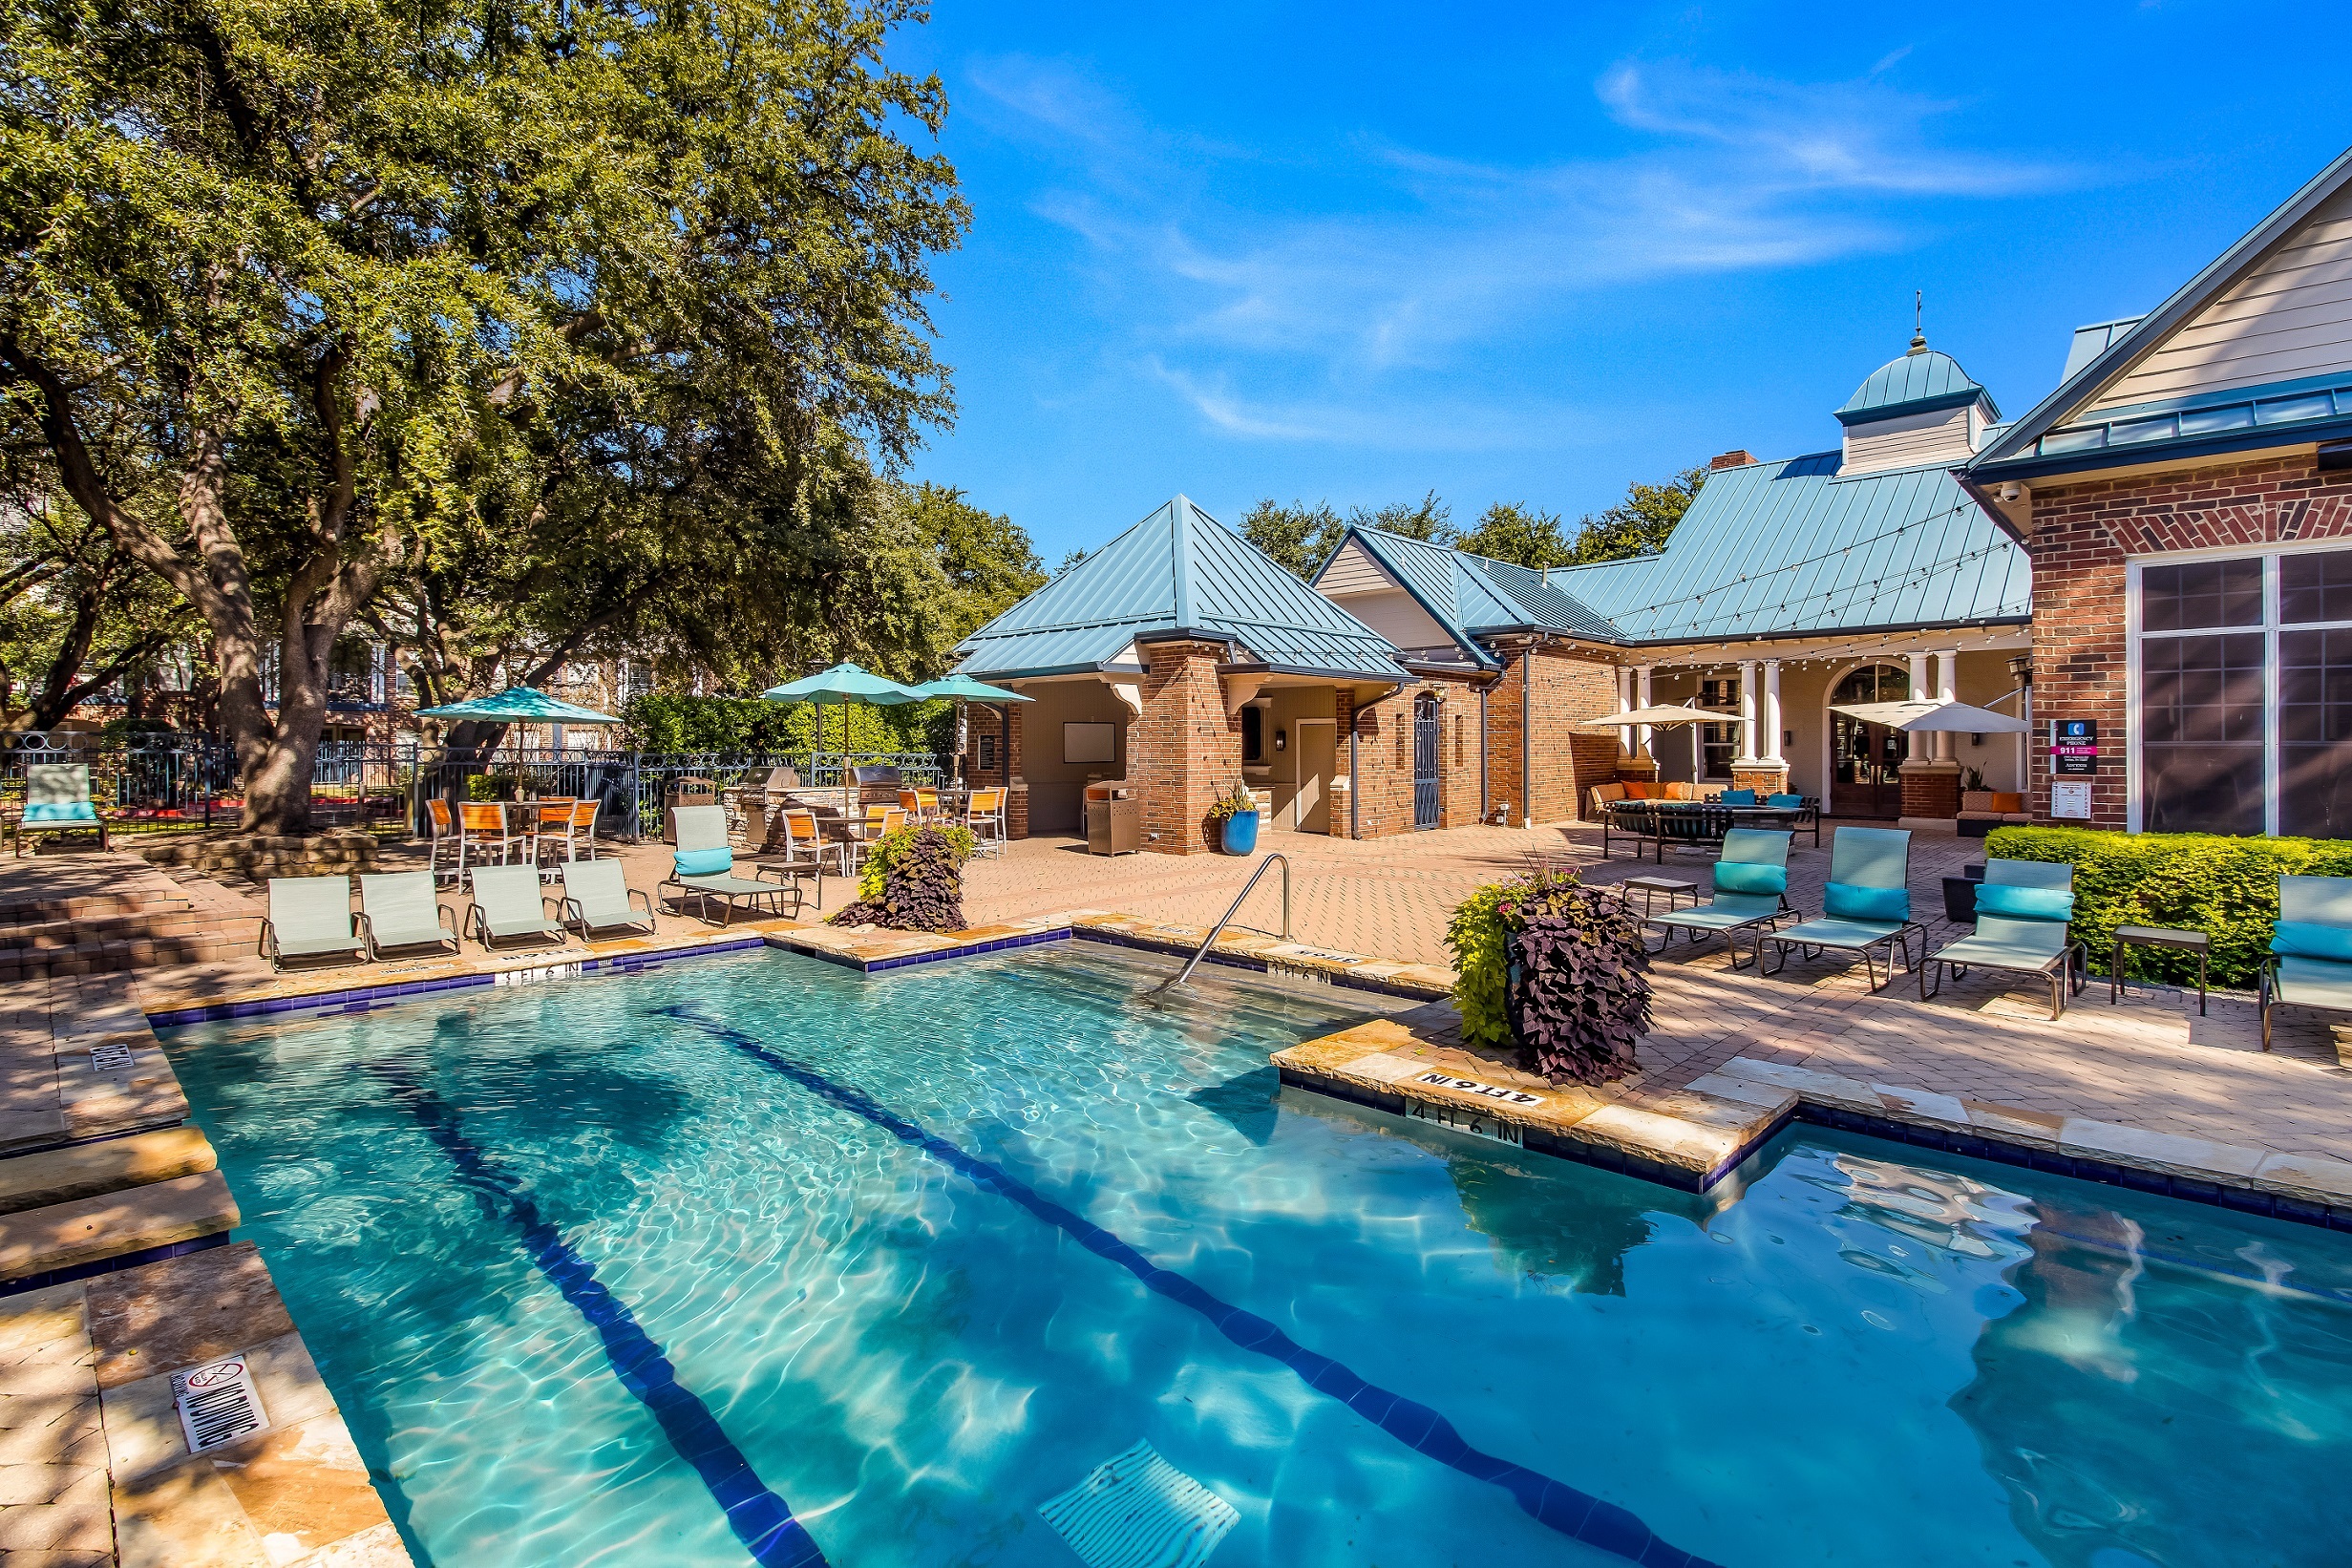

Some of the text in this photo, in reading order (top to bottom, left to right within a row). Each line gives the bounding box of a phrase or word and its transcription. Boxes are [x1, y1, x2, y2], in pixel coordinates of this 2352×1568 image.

[564, 961, 579, 973] IN
[1271, 964, 1328, 985] 3 FT 6 IN
[1422, 1072, 1537, 1103] 4 FT 6 IN
[1412, 1102, 1519, 1145] 4 FT 6 IN
[186, 1382, 260, 1448] NO DIVING
